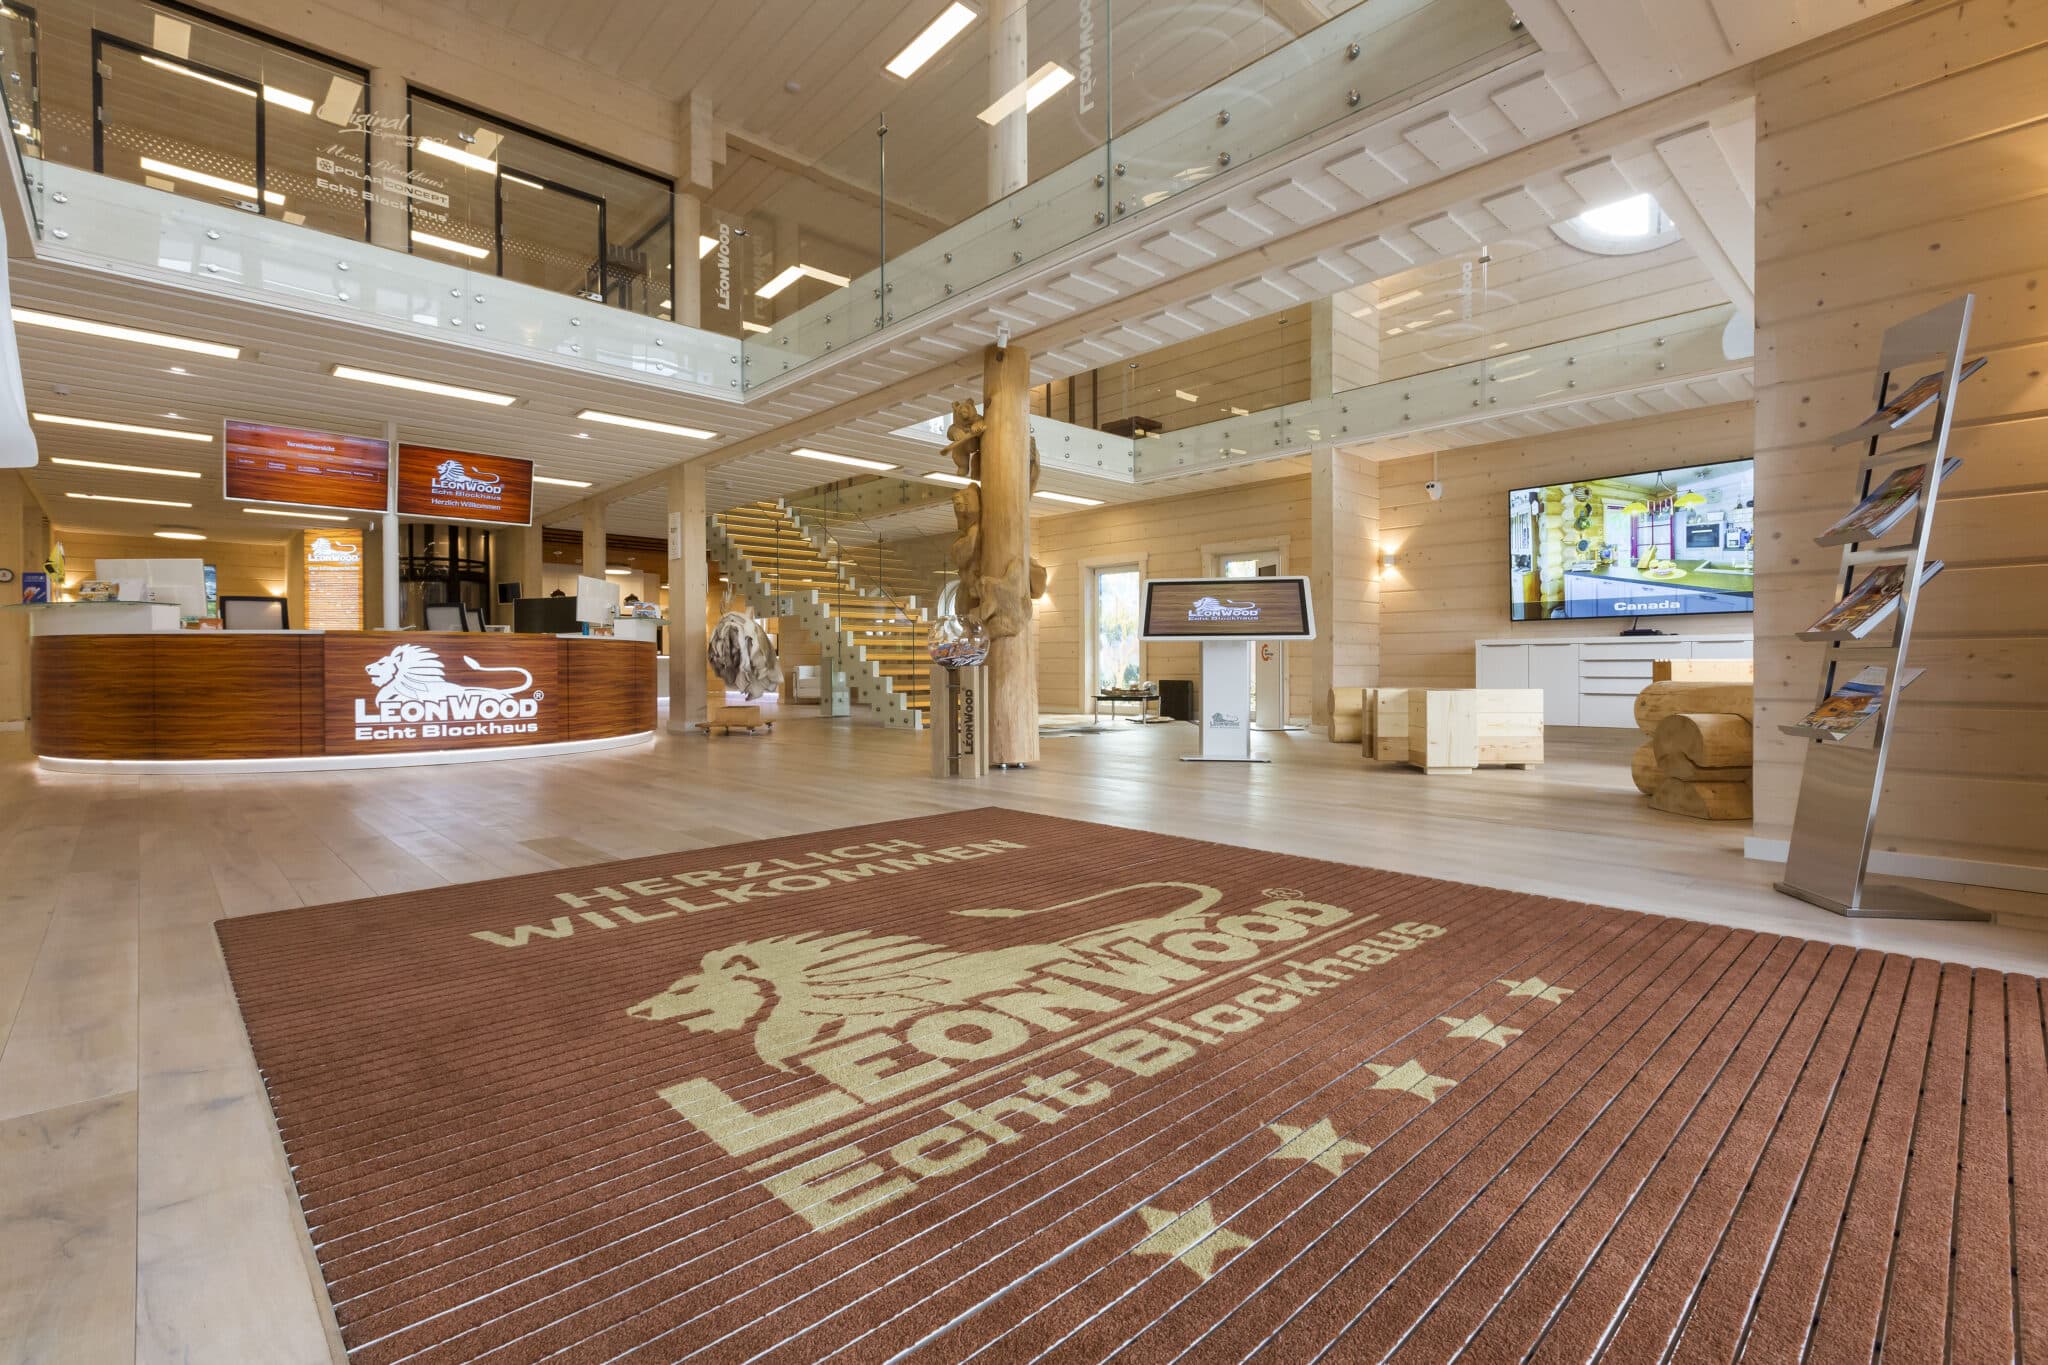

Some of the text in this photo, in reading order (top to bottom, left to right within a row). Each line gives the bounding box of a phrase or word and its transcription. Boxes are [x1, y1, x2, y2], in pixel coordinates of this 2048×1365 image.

[317, 178, 447, 222] Echt Blockhaus
[431, 487, 453, 496] Echt
[431, 498, 501, 511] Herzlich Willkommen
[1614, 600, 1680, 611] Canada
[355, 723, 539, 741] Echt Blockhaus
[554, 839, 925, 908] HERZLICH
[469, 839, 1027, 947] WILLKOMMEN
[763, 920, 1447, 1232] Echt Blockhaus
